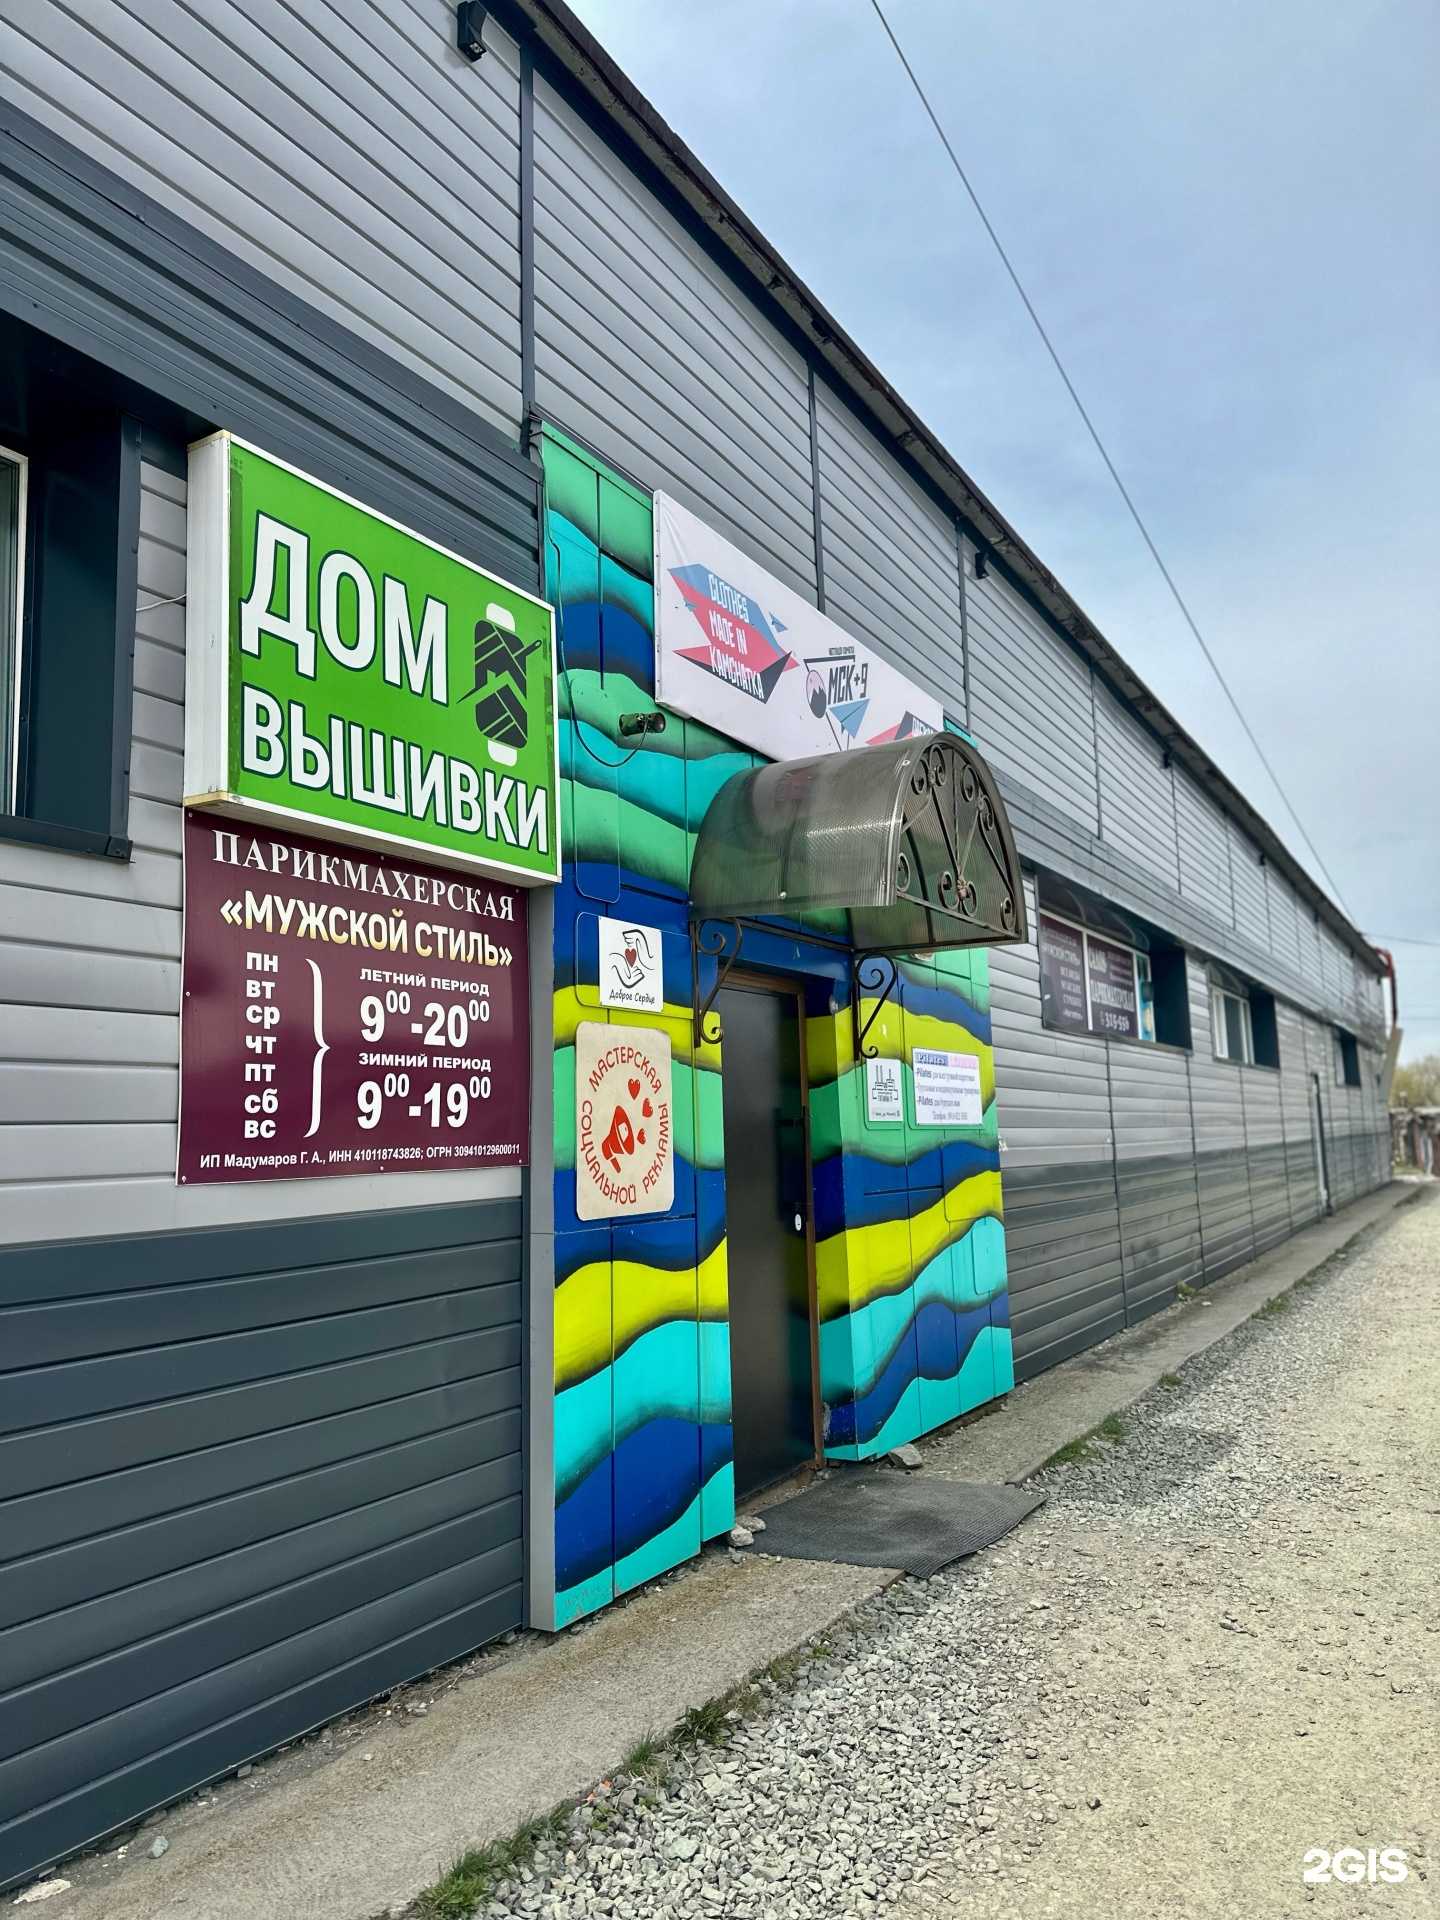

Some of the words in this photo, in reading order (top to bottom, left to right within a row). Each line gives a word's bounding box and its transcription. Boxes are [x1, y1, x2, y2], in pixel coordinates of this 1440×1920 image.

[240, 509, 449, 707] ДОМ
[708, 574, 750, 624] CLOTHES
[709, 609, 735, 648] MADE
[735, 627, 748, 655] IN
[709, 645, 765, 700] KAMCHATKA
[242, 682, 548, 855] ВЫШИВКИ
[211, 829, 516, 922] ПАРИКМАХЕРСКАЯ
[220, 890, 408, 954] «МУЖСКОЙ
[414, 921, 513, 967] СТИЛЬ»
[360, 968, 427, 988] ЛЕТНИЙ
[430, 977, 490, 997] ПЕРИОД
[358, 1052, 428, 1068] ЗИМНИЙ
[432, 1056, 492, 1072] ПЕРИОД
[588, 1046, 662, 1094] МАСТЕРСКАЯ
[200, 1154, 220, 1168] ИП
[224, 1153, 298, 1169] Мадумаров
[328, 1150, 352, 1162] ИНН
[426, 1147, 451, 1158] ОГРН
[581, 1100, 637, 1205] СОЦИАЛЬНОЙ
[642, 1103, 669, 1194] РЕКЛАМЫ
